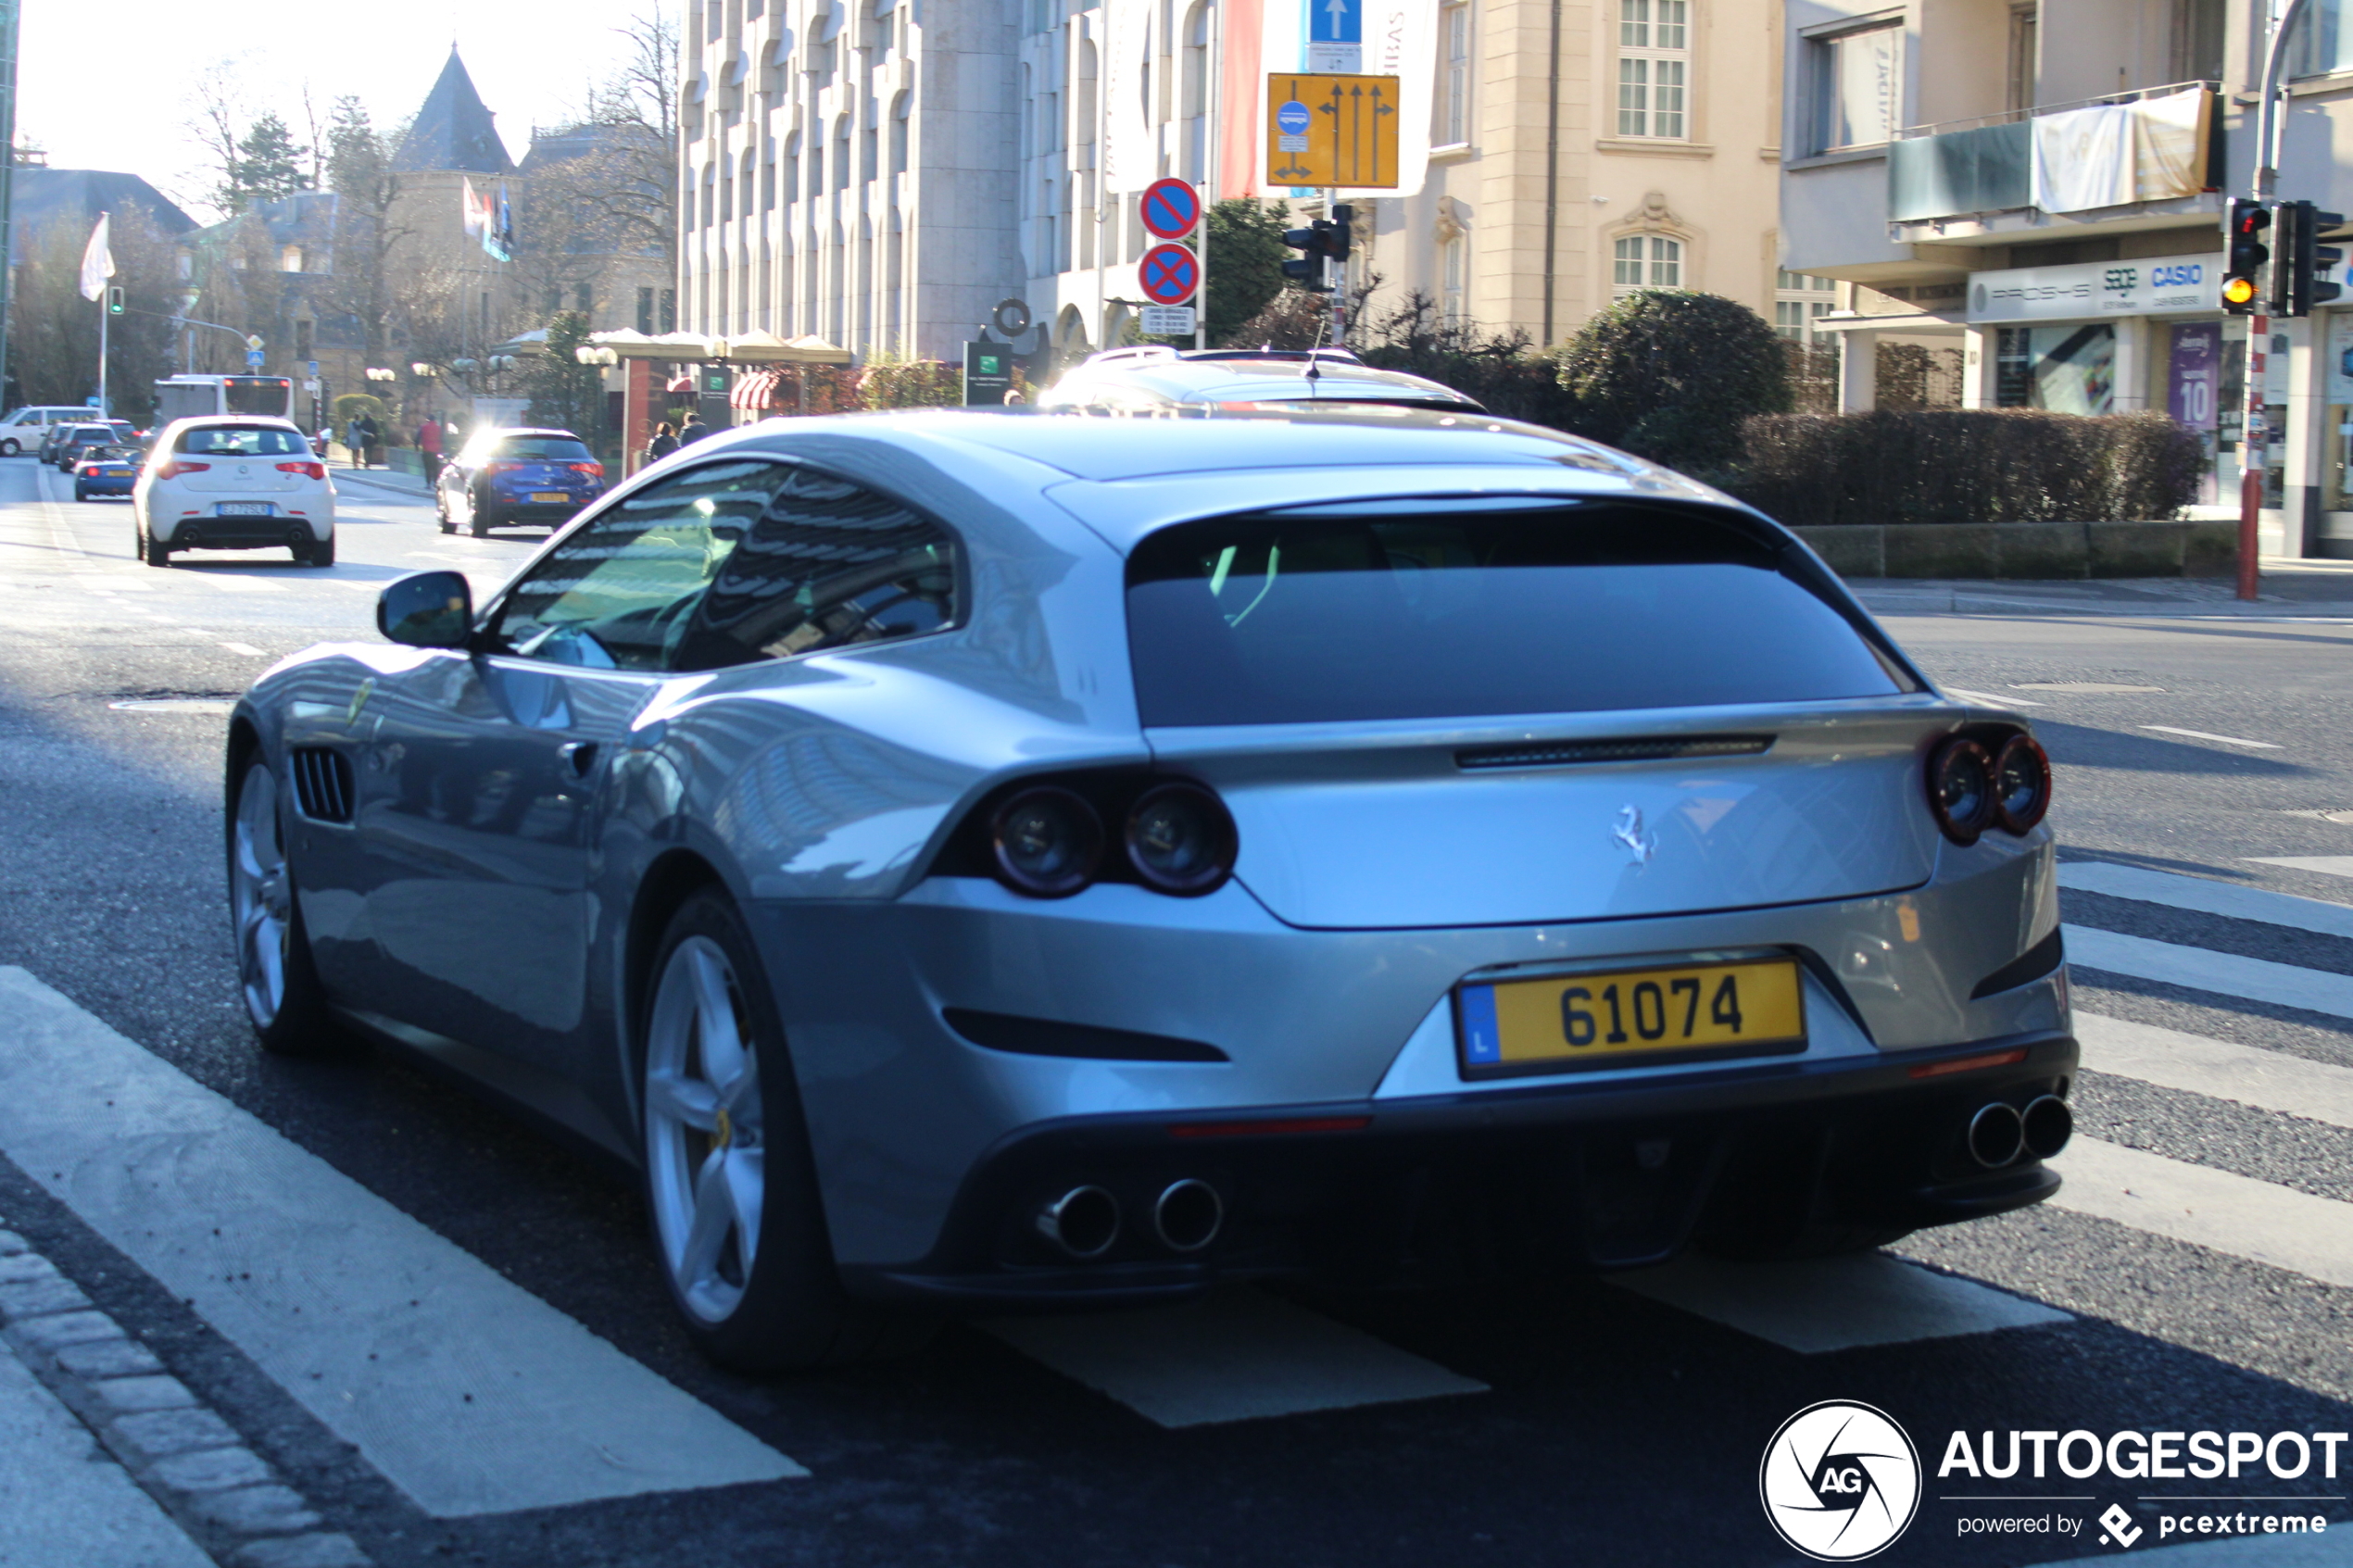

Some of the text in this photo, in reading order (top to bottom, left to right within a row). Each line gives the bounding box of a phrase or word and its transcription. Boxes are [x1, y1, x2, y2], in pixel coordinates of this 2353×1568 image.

[2104, 268, 2138, 297] sage
[2152, 264, 2203, 288] CASIO
[2180, 381, 2209, 421] 10
[1560, 974, 1743, 1047] 61074
[1474, 1032, 1488, 1053] L
